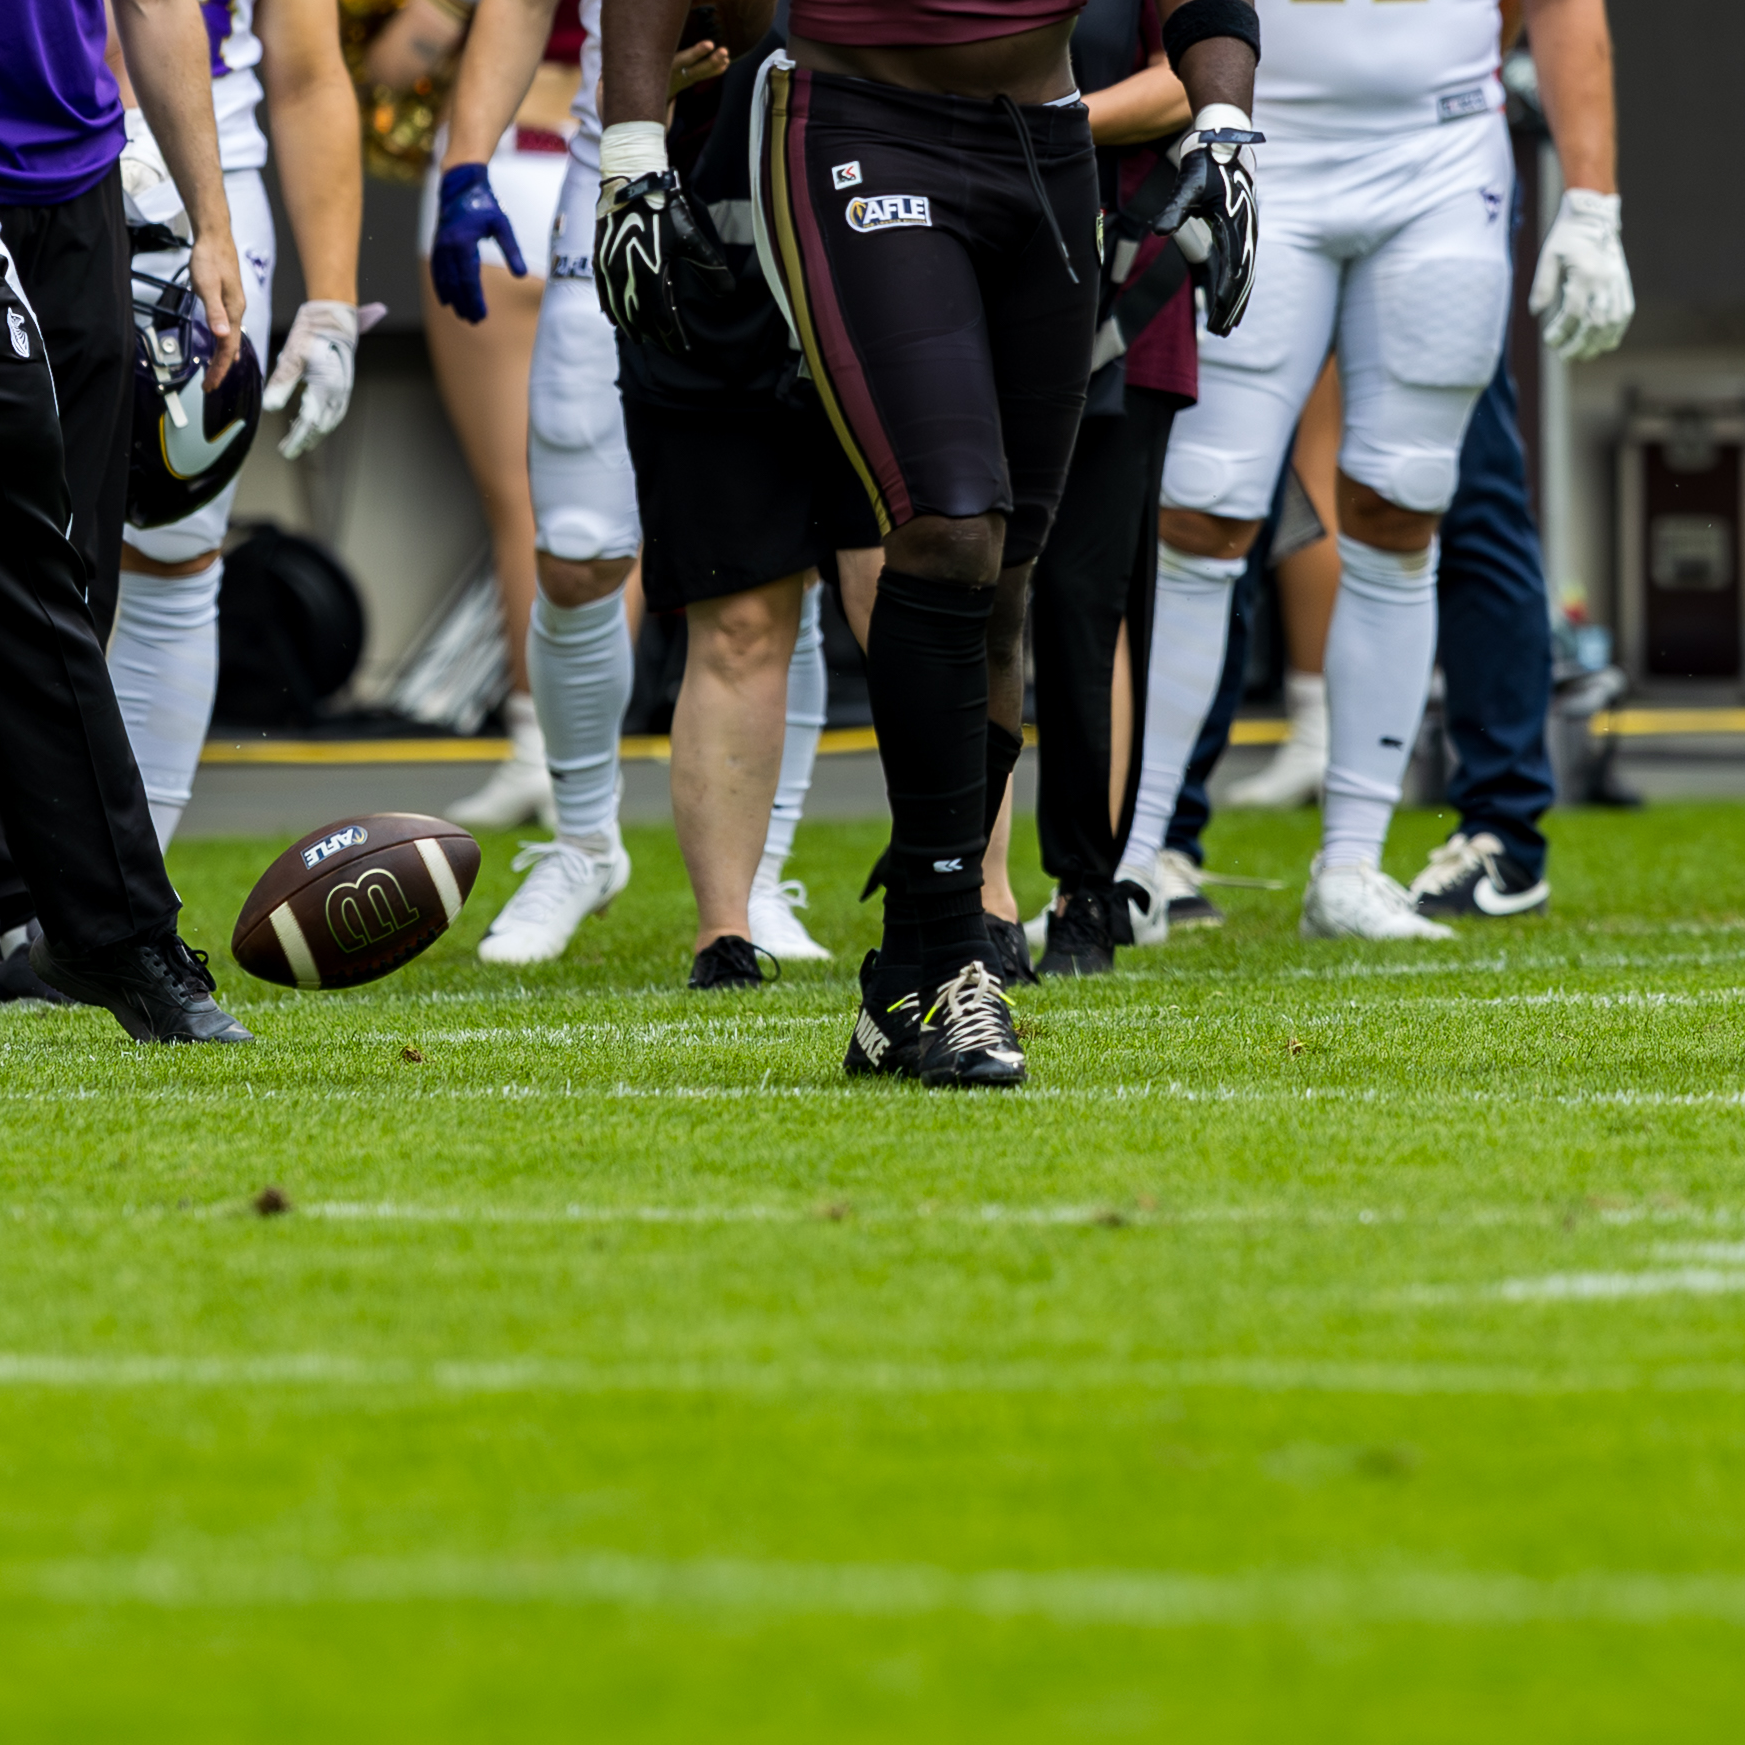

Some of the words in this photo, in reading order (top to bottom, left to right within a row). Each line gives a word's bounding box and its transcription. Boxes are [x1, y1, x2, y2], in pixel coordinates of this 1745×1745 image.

[863, 198, 926, 223] AFLE
[304, 828, 354, 867] AFLE
[325, 868, 420, 954] W
[855, 1007, 891, 1068] NIKE
